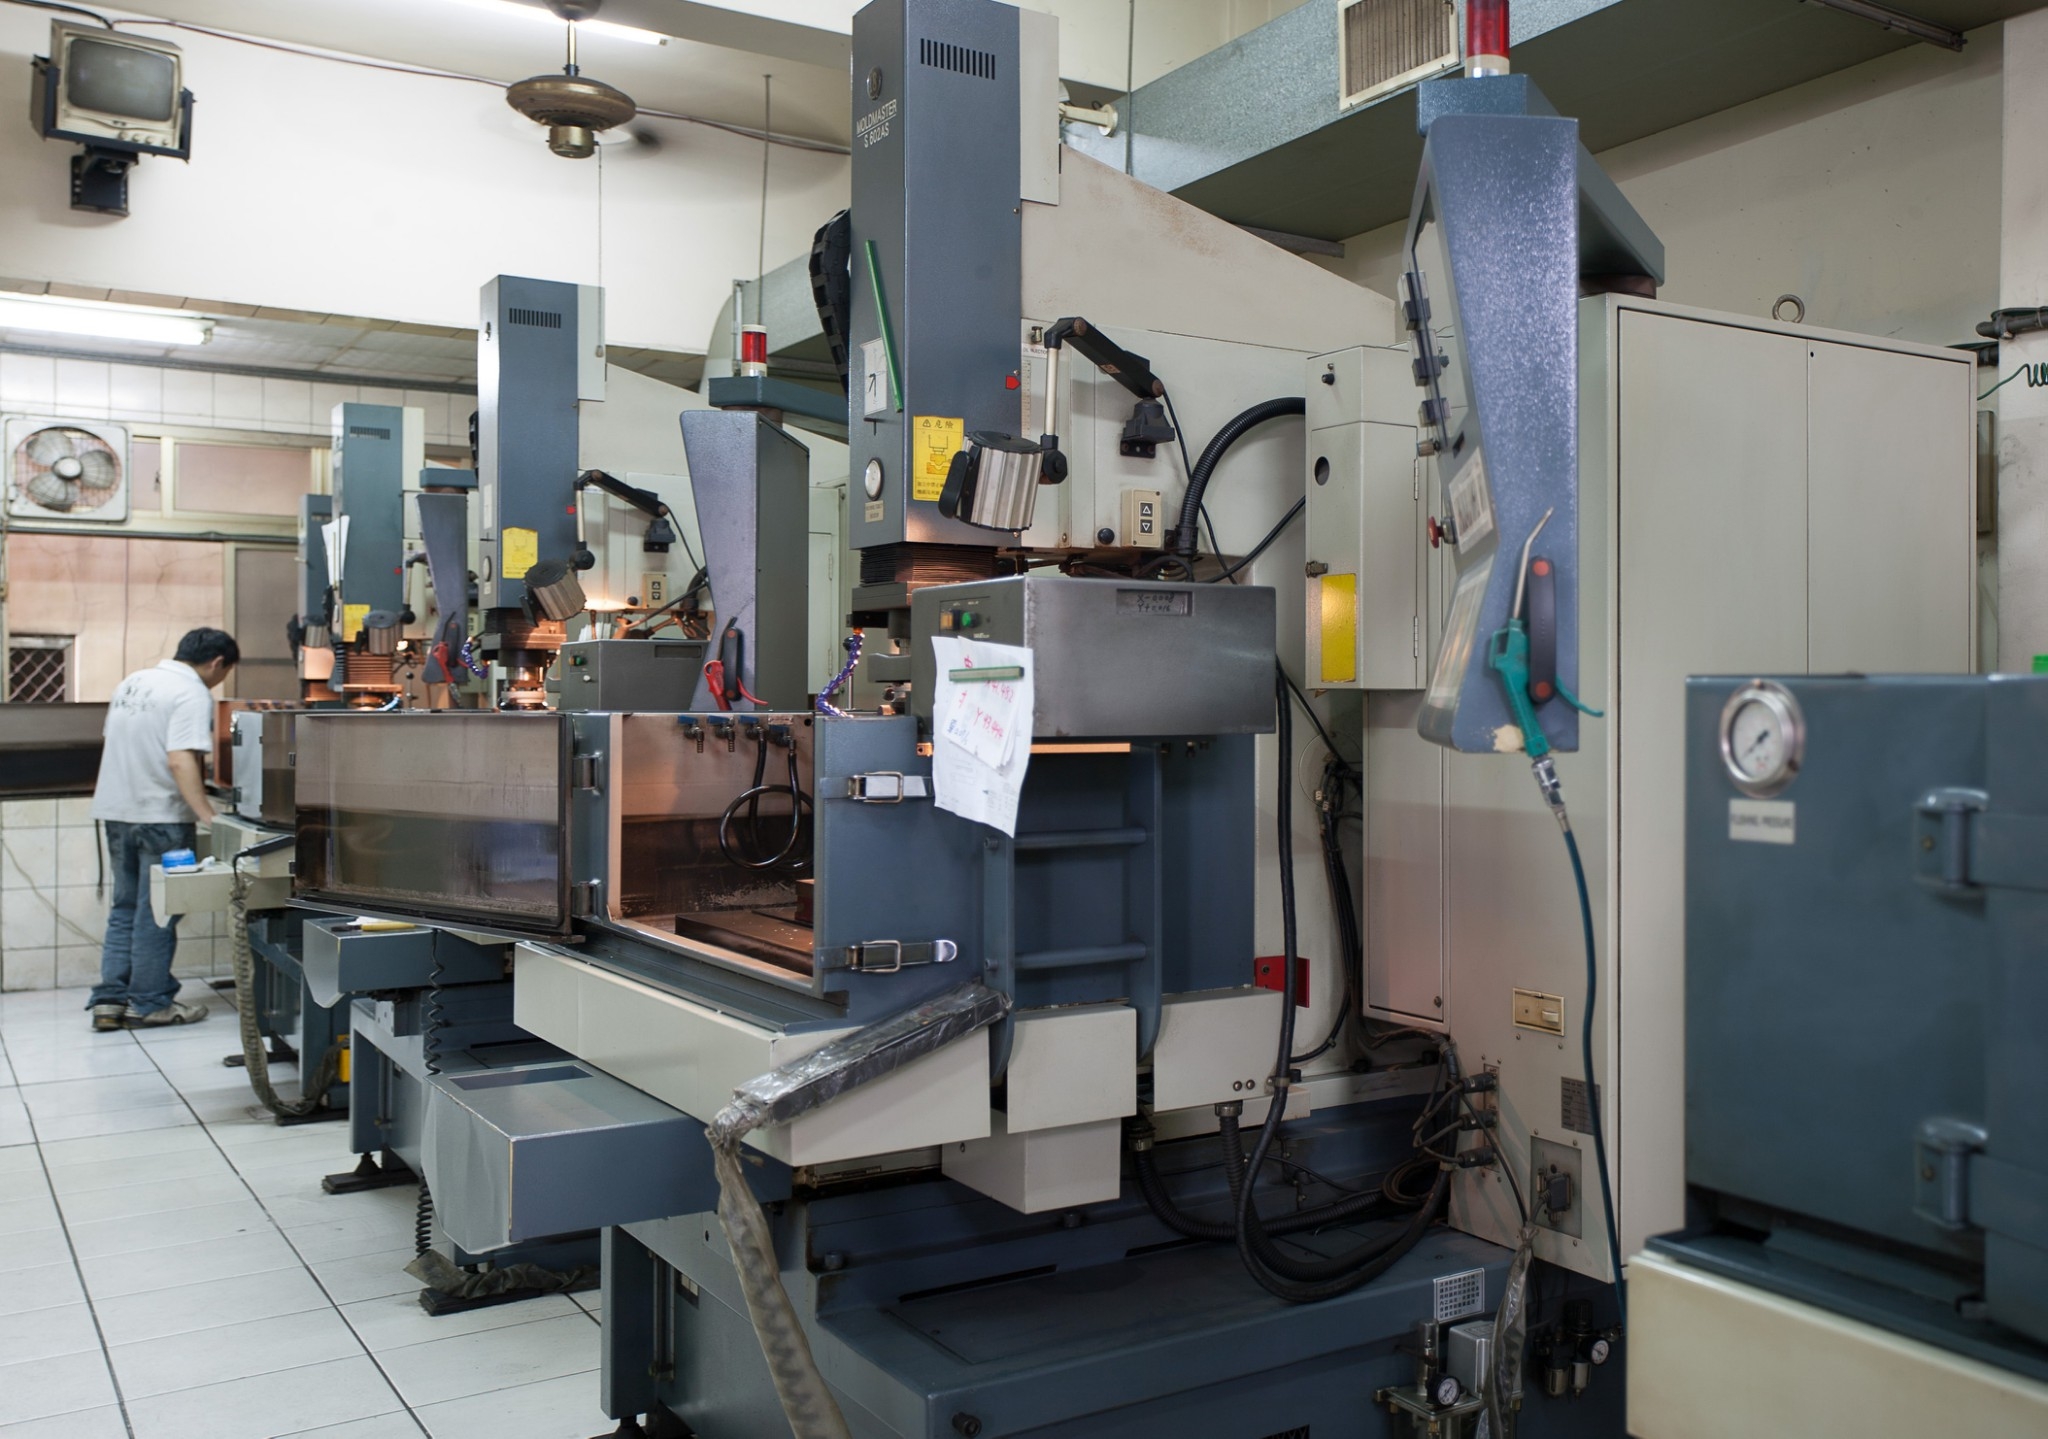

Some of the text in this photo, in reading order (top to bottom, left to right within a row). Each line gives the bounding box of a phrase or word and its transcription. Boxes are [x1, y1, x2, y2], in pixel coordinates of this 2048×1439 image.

[856, 99, 897, 134] MOLDMASTER
[864, 122, 890, 148] S 602AS
[934, 419, 954, 429] 危險
